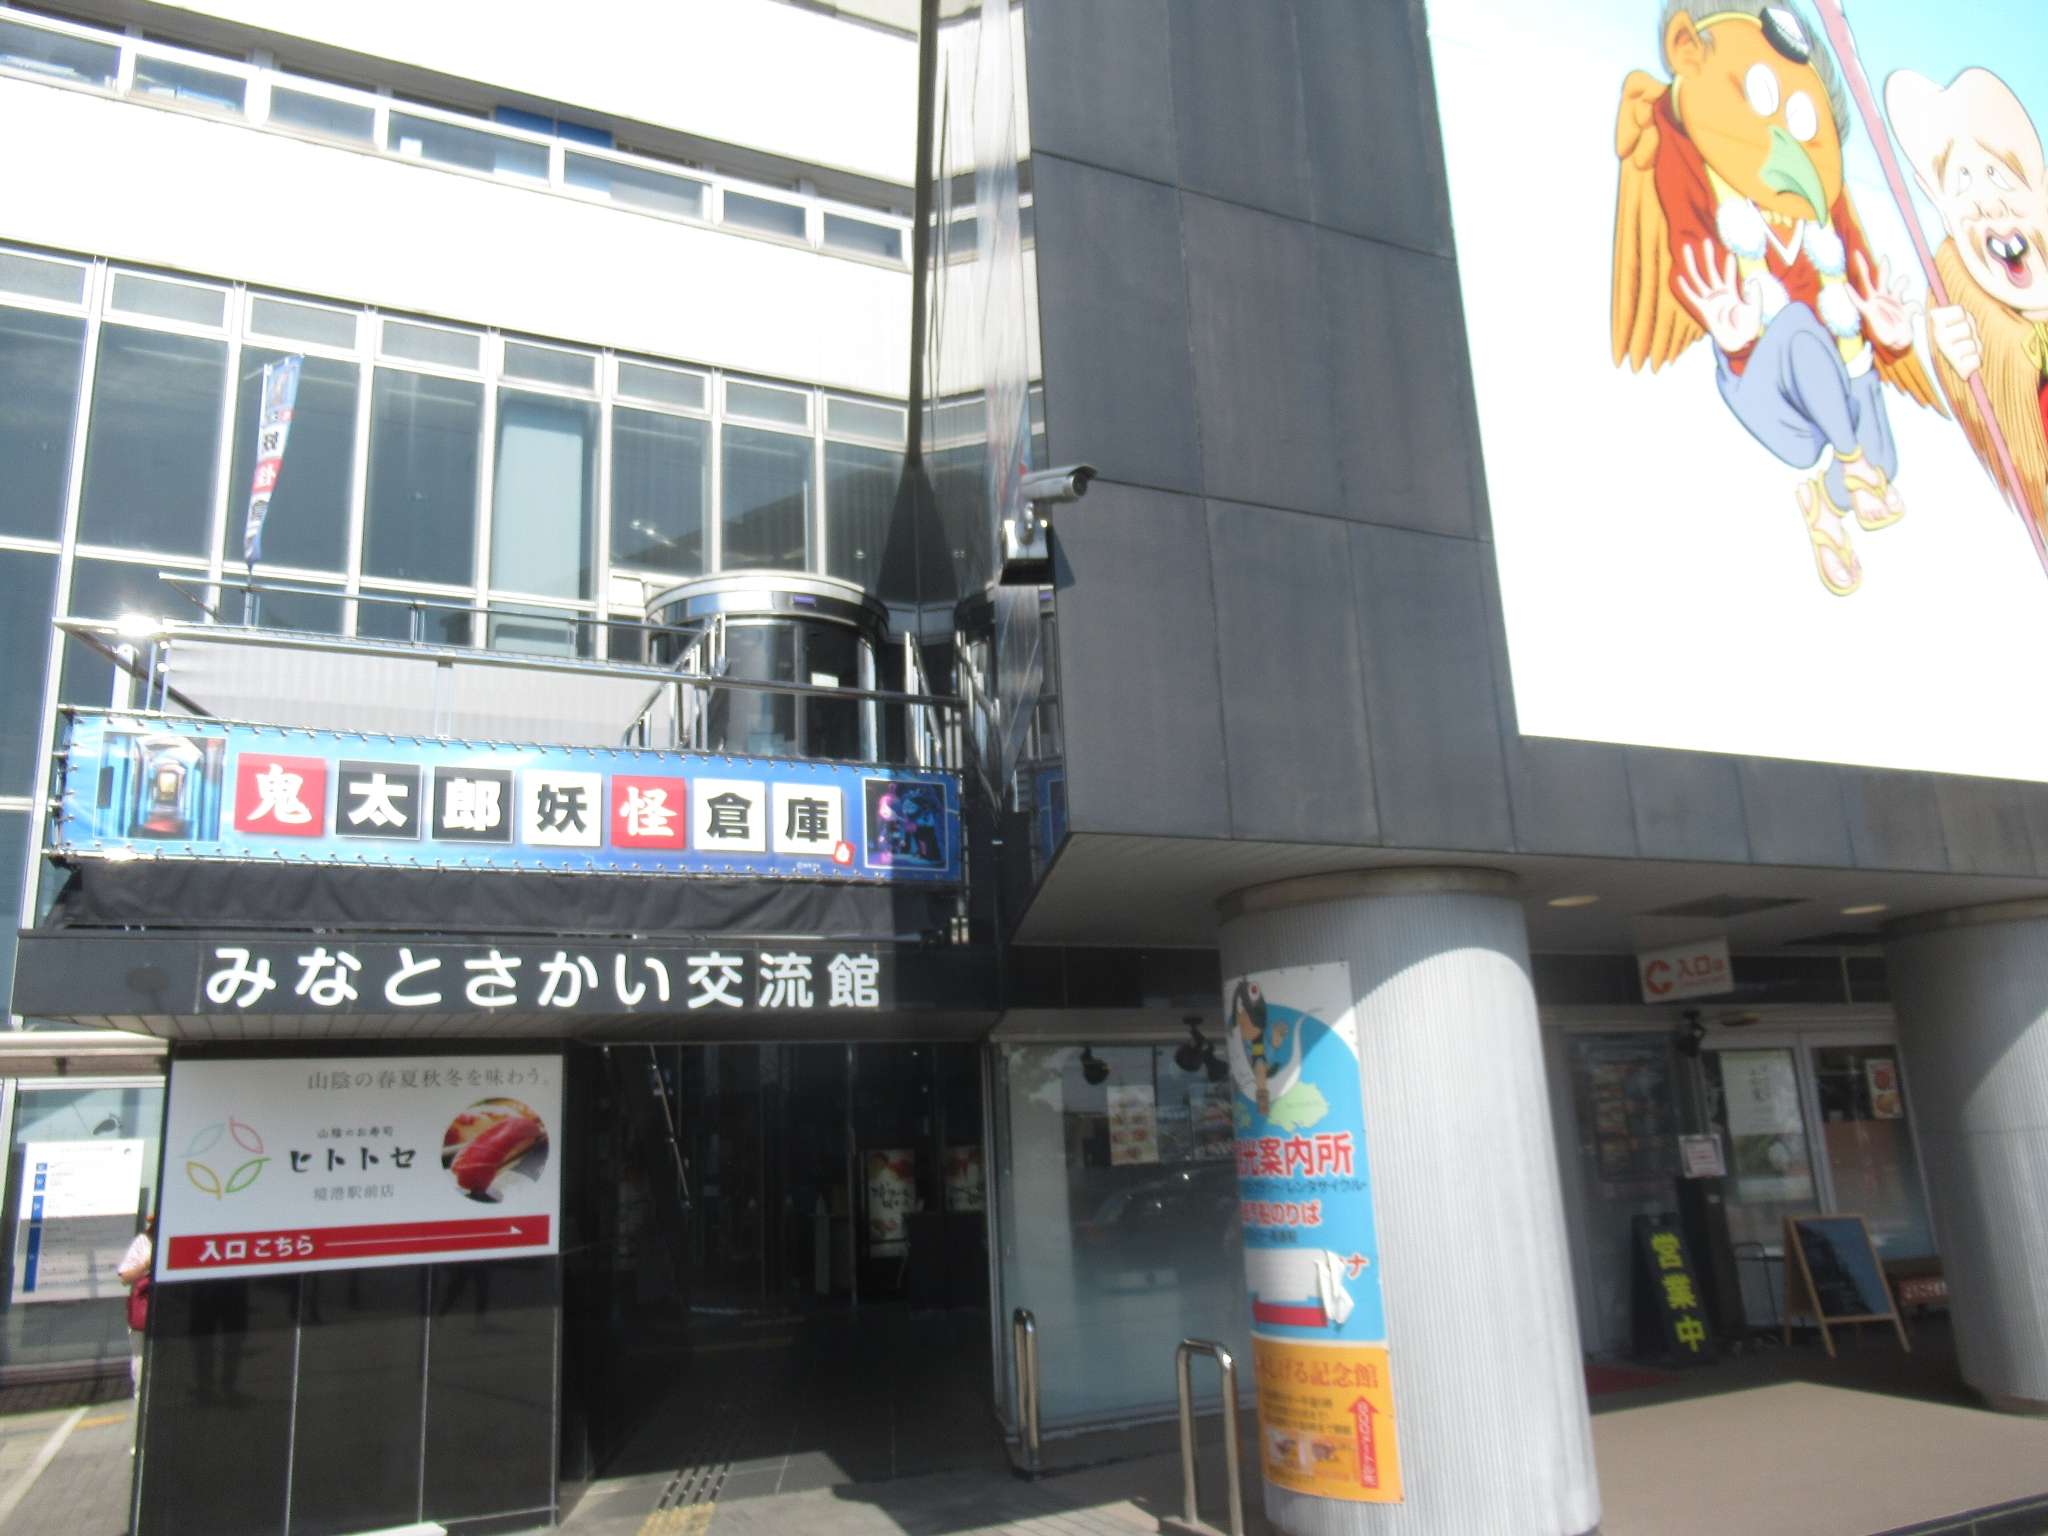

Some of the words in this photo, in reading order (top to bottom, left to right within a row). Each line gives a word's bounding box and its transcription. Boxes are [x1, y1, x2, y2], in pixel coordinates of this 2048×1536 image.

[248, 763, 830, 842] 鬼太郎妖怪倉庫
[207, 948, 880, 1008] みなとさかい交流館
[291, 1146, 416, 1173] ヒトトセ
[199, 1235, 314, 1262] 入口こちら
[1650, 1231, 1707, 1353] 営業中
